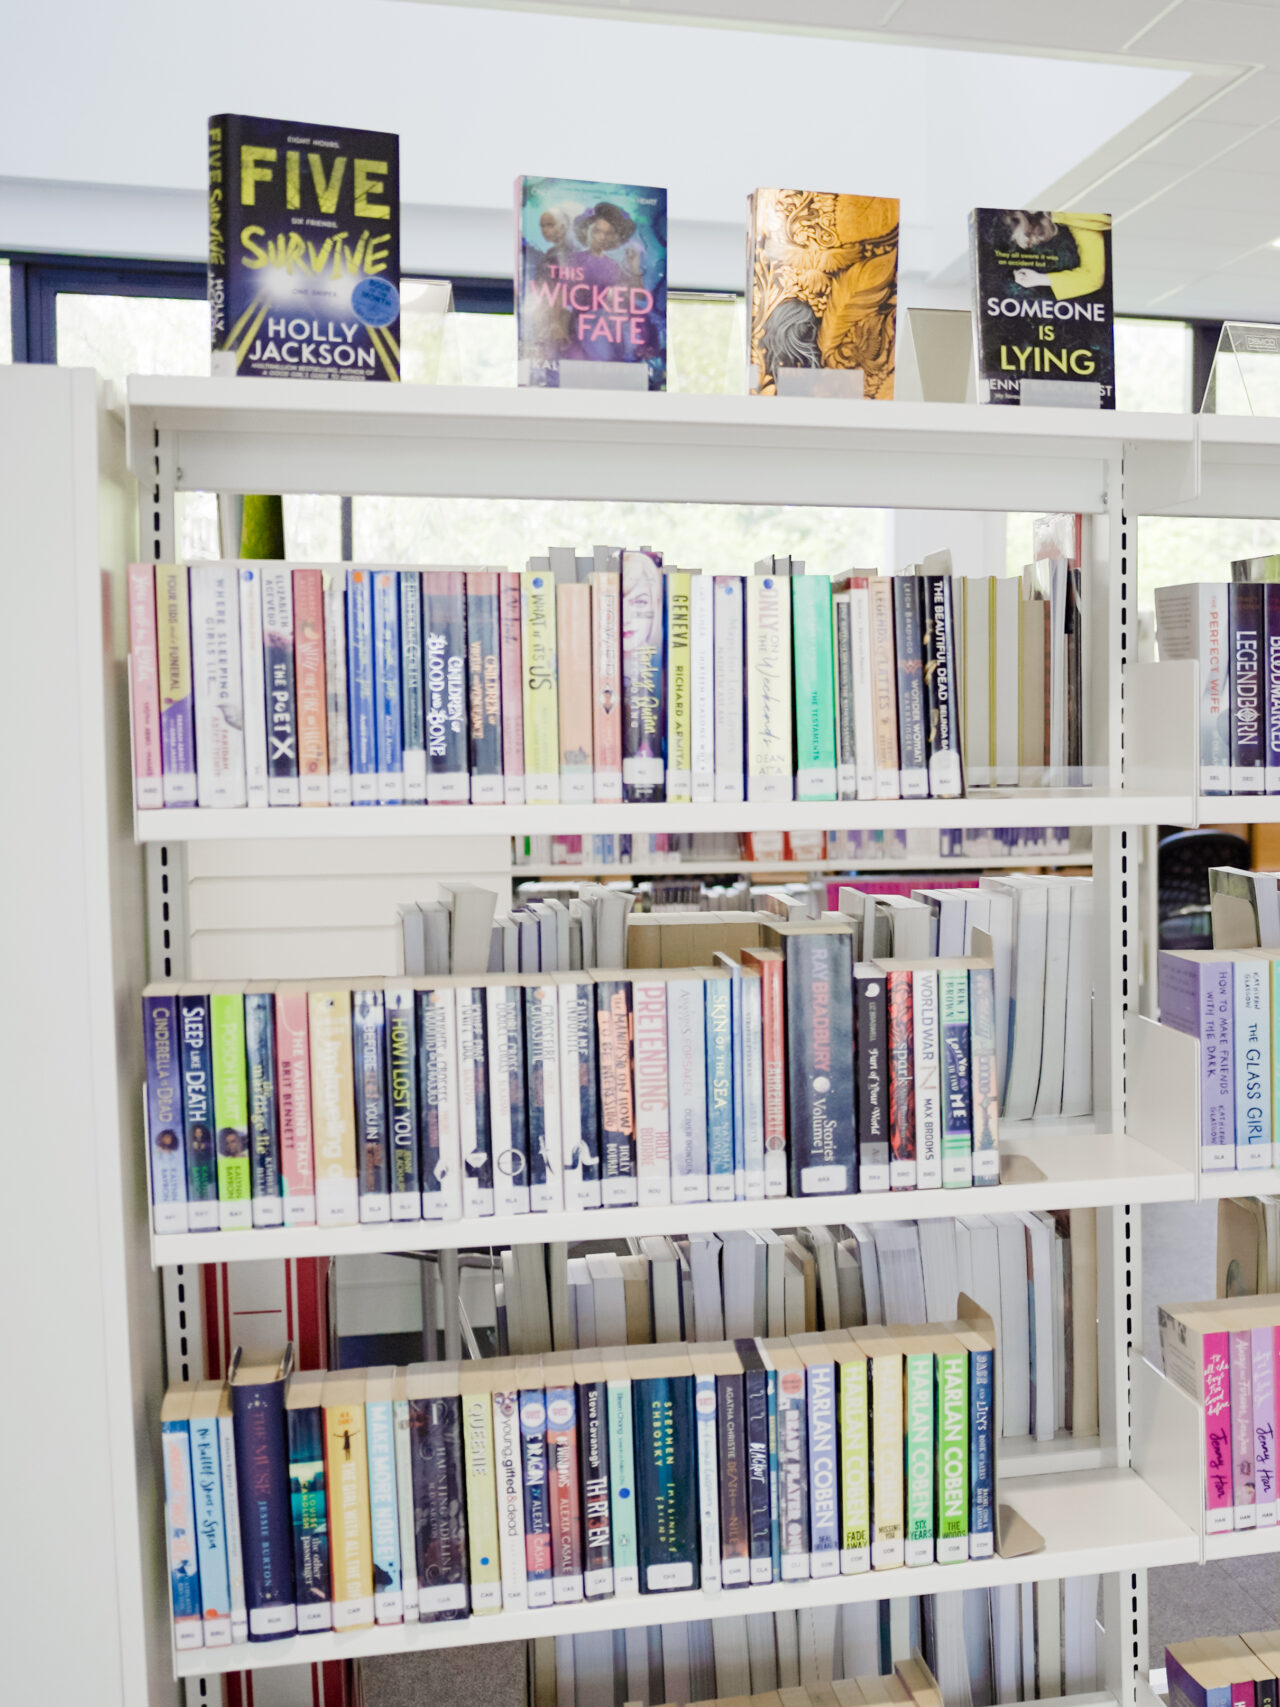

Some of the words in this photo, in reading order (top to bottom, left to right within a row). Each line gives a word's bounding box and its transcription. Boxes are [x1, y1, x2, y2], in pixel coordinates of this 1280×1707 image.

[240, 144, 391, 220] FIVE
[240, 224, 391, 280] SURVIVE
[547, 265, 585, 281] THIS
[531, 281, 654, 316] WICKED
[987, 297, 1106, 322] SOMEONE
[268, 317, 359, 343] HOLLY
[578, 314, 646, 345] FATE
[1039, 325, 1055, 341] IS
[248, 340, 376, 368] JACKSON
[1000, 345, 1096, 376] LYING
[275, 575, 288, 627] ELIZABETH
[934, 581, 943, 603] THE
[672, 595, 688, 648] GENEVA
[934, 606, 946, 666] BEAUTIFUL
[1209, 612, 1219, 672] PERFECT
[273, 664, 286, 686] THE
[427, 633, 447, 691] BLOOD
[447, 656, 463, 721] CHILDREN
[912, 680, 921, 721] WONDER
[937, 668, 947, 700] DEAD
[1210, 680, 1219, 714] WIFE
[1235, 631, 1260, 744] LEGENDBORN
[272, 691, 290, 733] POET
[271, 737, 294, 759] X
[427, 709, 447, 756] BONE
[913, 724, 922, 763] WOMAN
[920, 976, 933, 1026] WORLD
[153, 1008, 170, 1078] CINDERELLA
[182, 1007, 205, 1048] SLEEP
[392, 1018, 409, 1057] HOW
[812, 982, 830, 1071] BRADBURY
[923, 1030, 935, 1060] WAR
[1247, 1023, 1258, 1043] THE
[190, 1051, 201, 1068] LIKE
[637, 987, 668, 1111] PRETENDING
[393, 1069, 411, 1109] LOST
[1246, 1048, 1261, 1101] GLASS
[158, 1087, 174, 1122] DEAD
[187, 1071, 206, 1122] DEATH
[924, 1099, 933, 1118] MAX
[395, 1112, 411, 1145] YOU
[924, 1122, 934, 1160] BROOKS
[1246, 1107, 1262, 1145] GIRL
[588, 1391, 598, 1417] Steve
[726, 1387, 734, 1420] AGATHA
[944, 1360, 963, 1441] HARLAN
[589, 1420, 600, 1467] Cavanagh
[652, 1402, 662, 1467] CHBOSKY
[664, 1402, 674, 1465] STEPHEN
[727, 1422, 736, 1458] CHRISTIE
[1209, 1428, 1227, 1467] Jenny
[944, 1447, 963, 1516] COBEN
[1214, 1475, 1227, 1499] Han
[257, 1501, 268, 1535] JESSIE
[260, 1542, 272, 1587] BURTON
